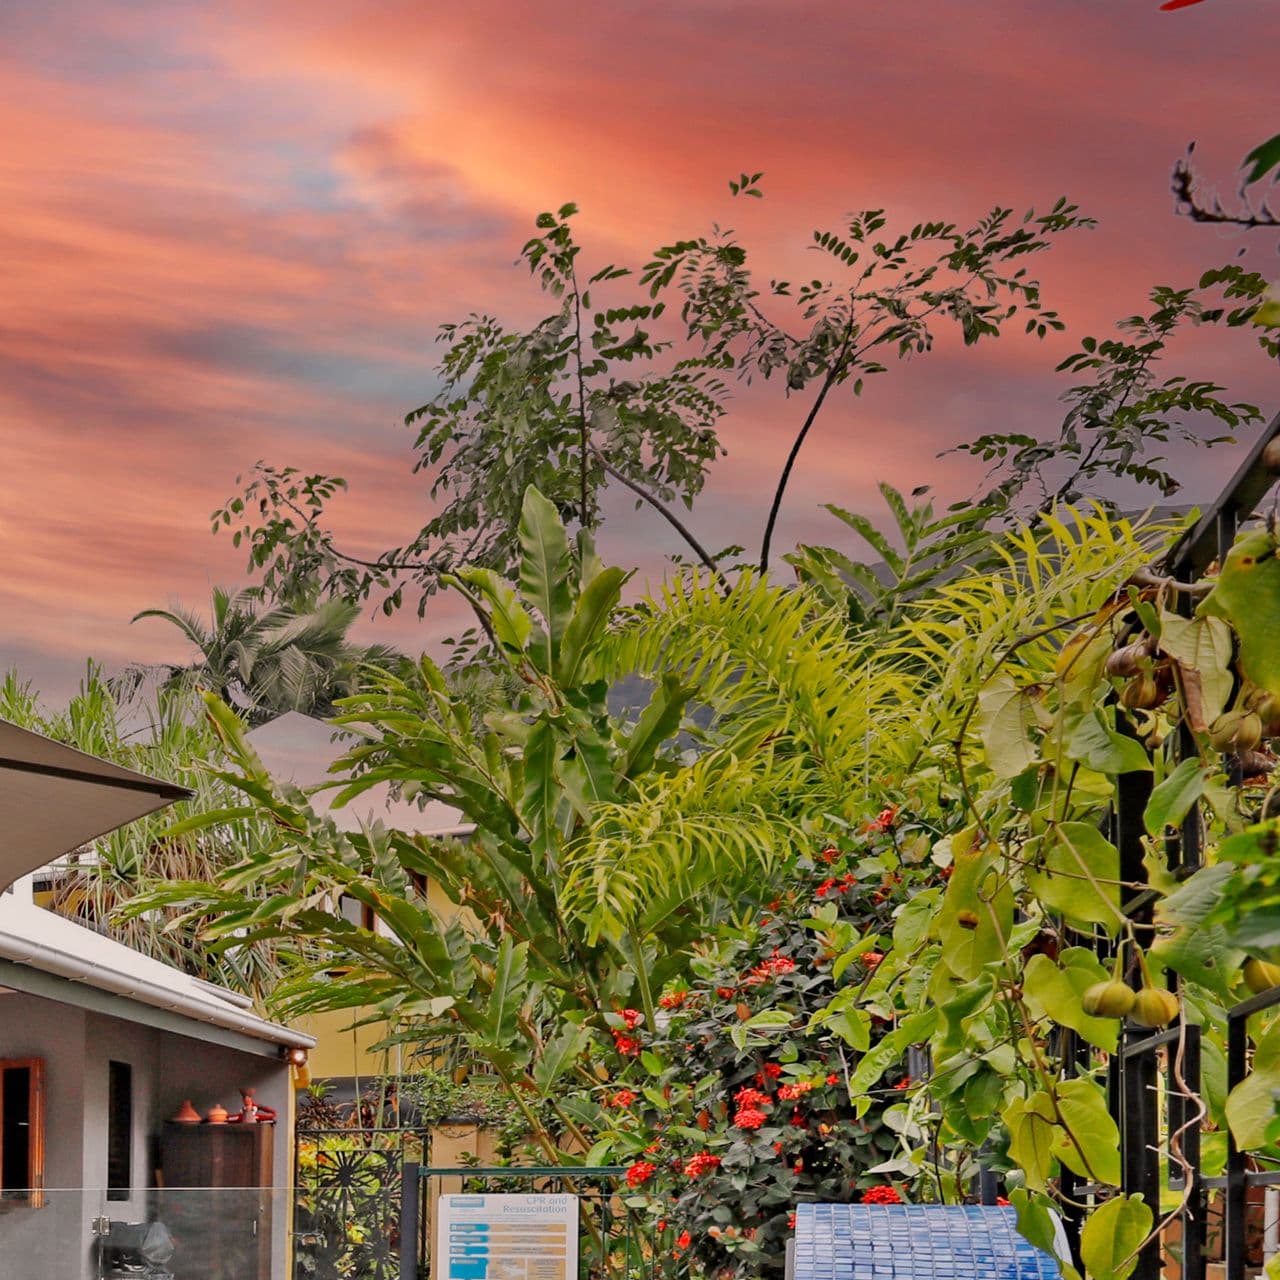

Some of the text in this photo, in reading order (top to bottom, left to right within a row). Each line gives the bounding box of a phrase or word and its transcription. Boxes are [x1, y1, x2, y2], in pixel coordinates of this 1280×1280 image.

[526, 1196, 567, 1205] CPR and
[503, 1205, 567, 1213] Resuscitation
